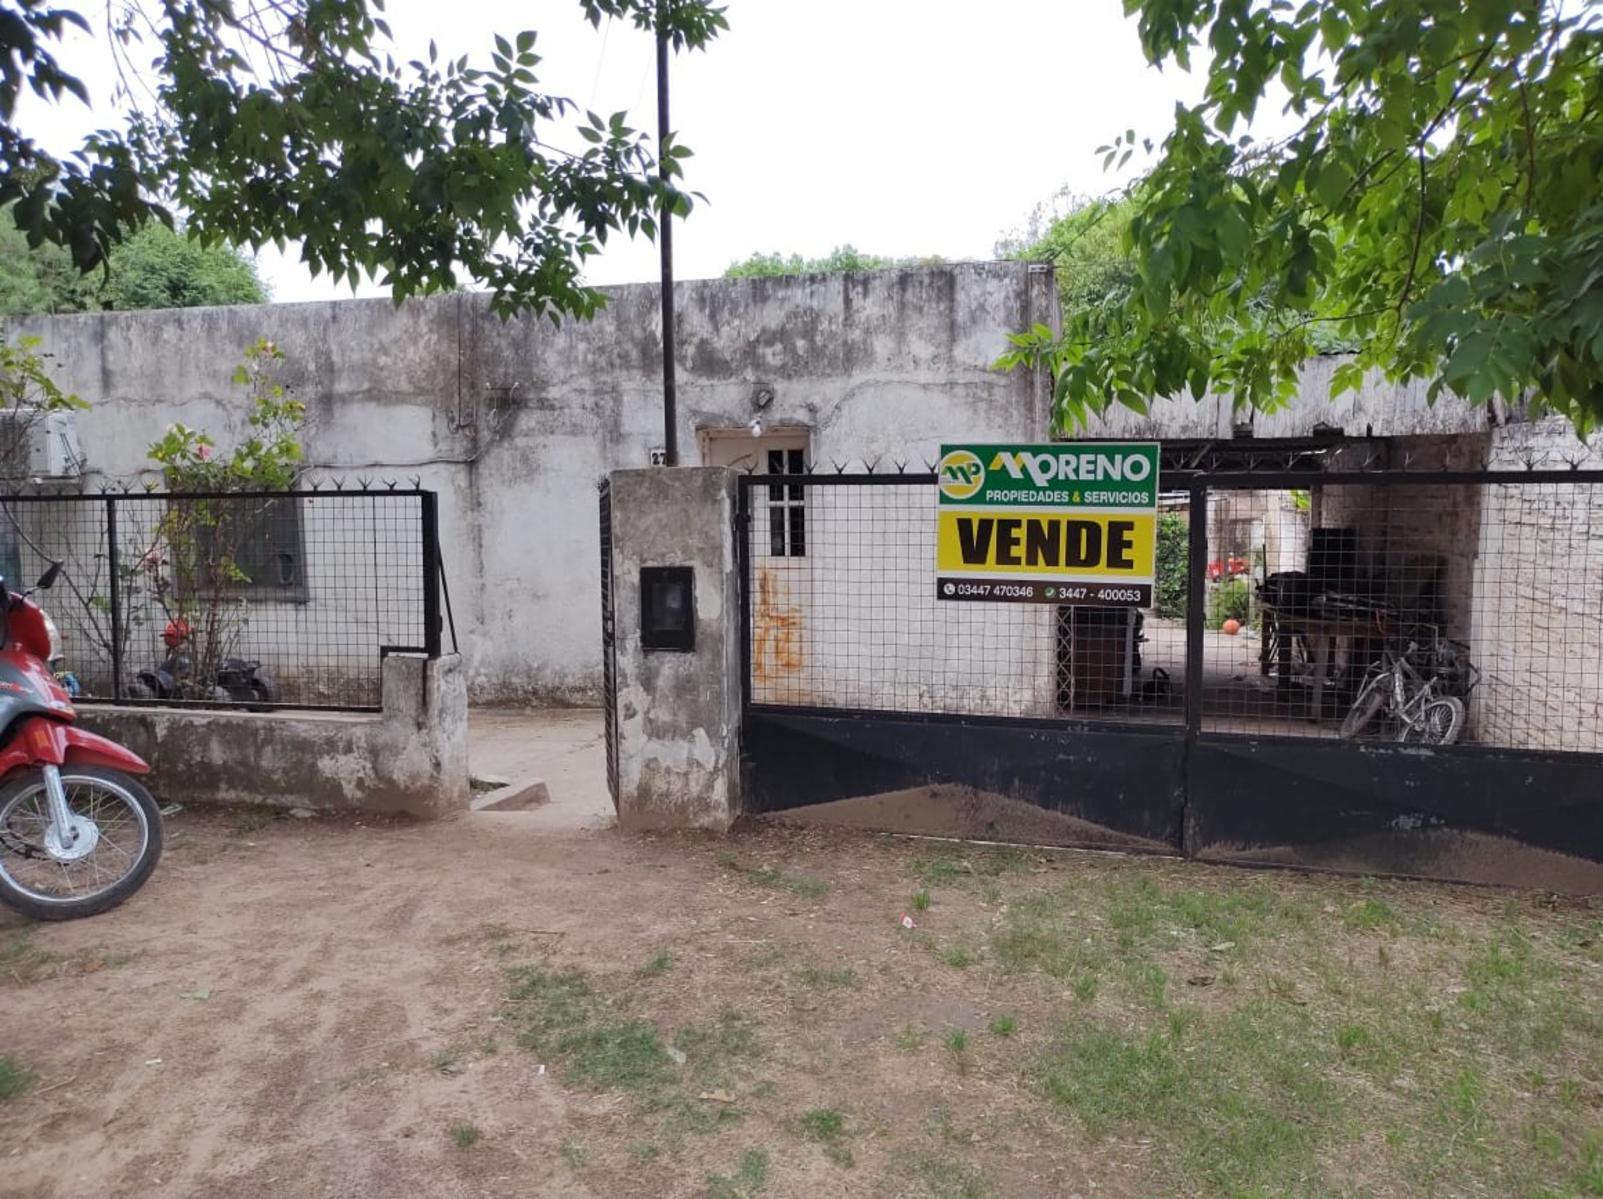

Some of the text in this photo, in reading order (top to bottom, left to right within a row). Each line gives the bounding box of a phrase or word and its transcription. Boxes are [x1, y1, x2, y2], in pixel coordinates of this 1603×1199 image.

[988, 451, 1150, 486] MORENO
[986, 490, 1149, 504] PROPIEDADES & SERVICIOS
[956, 517, 1135, 570] VENDE
[957, 583, 991, 596] 03447
[993, 585, 1034, 598] 470346
[1059, 587, 1087, 600] 3447
[1098, 589, 1141, 602] 400053
